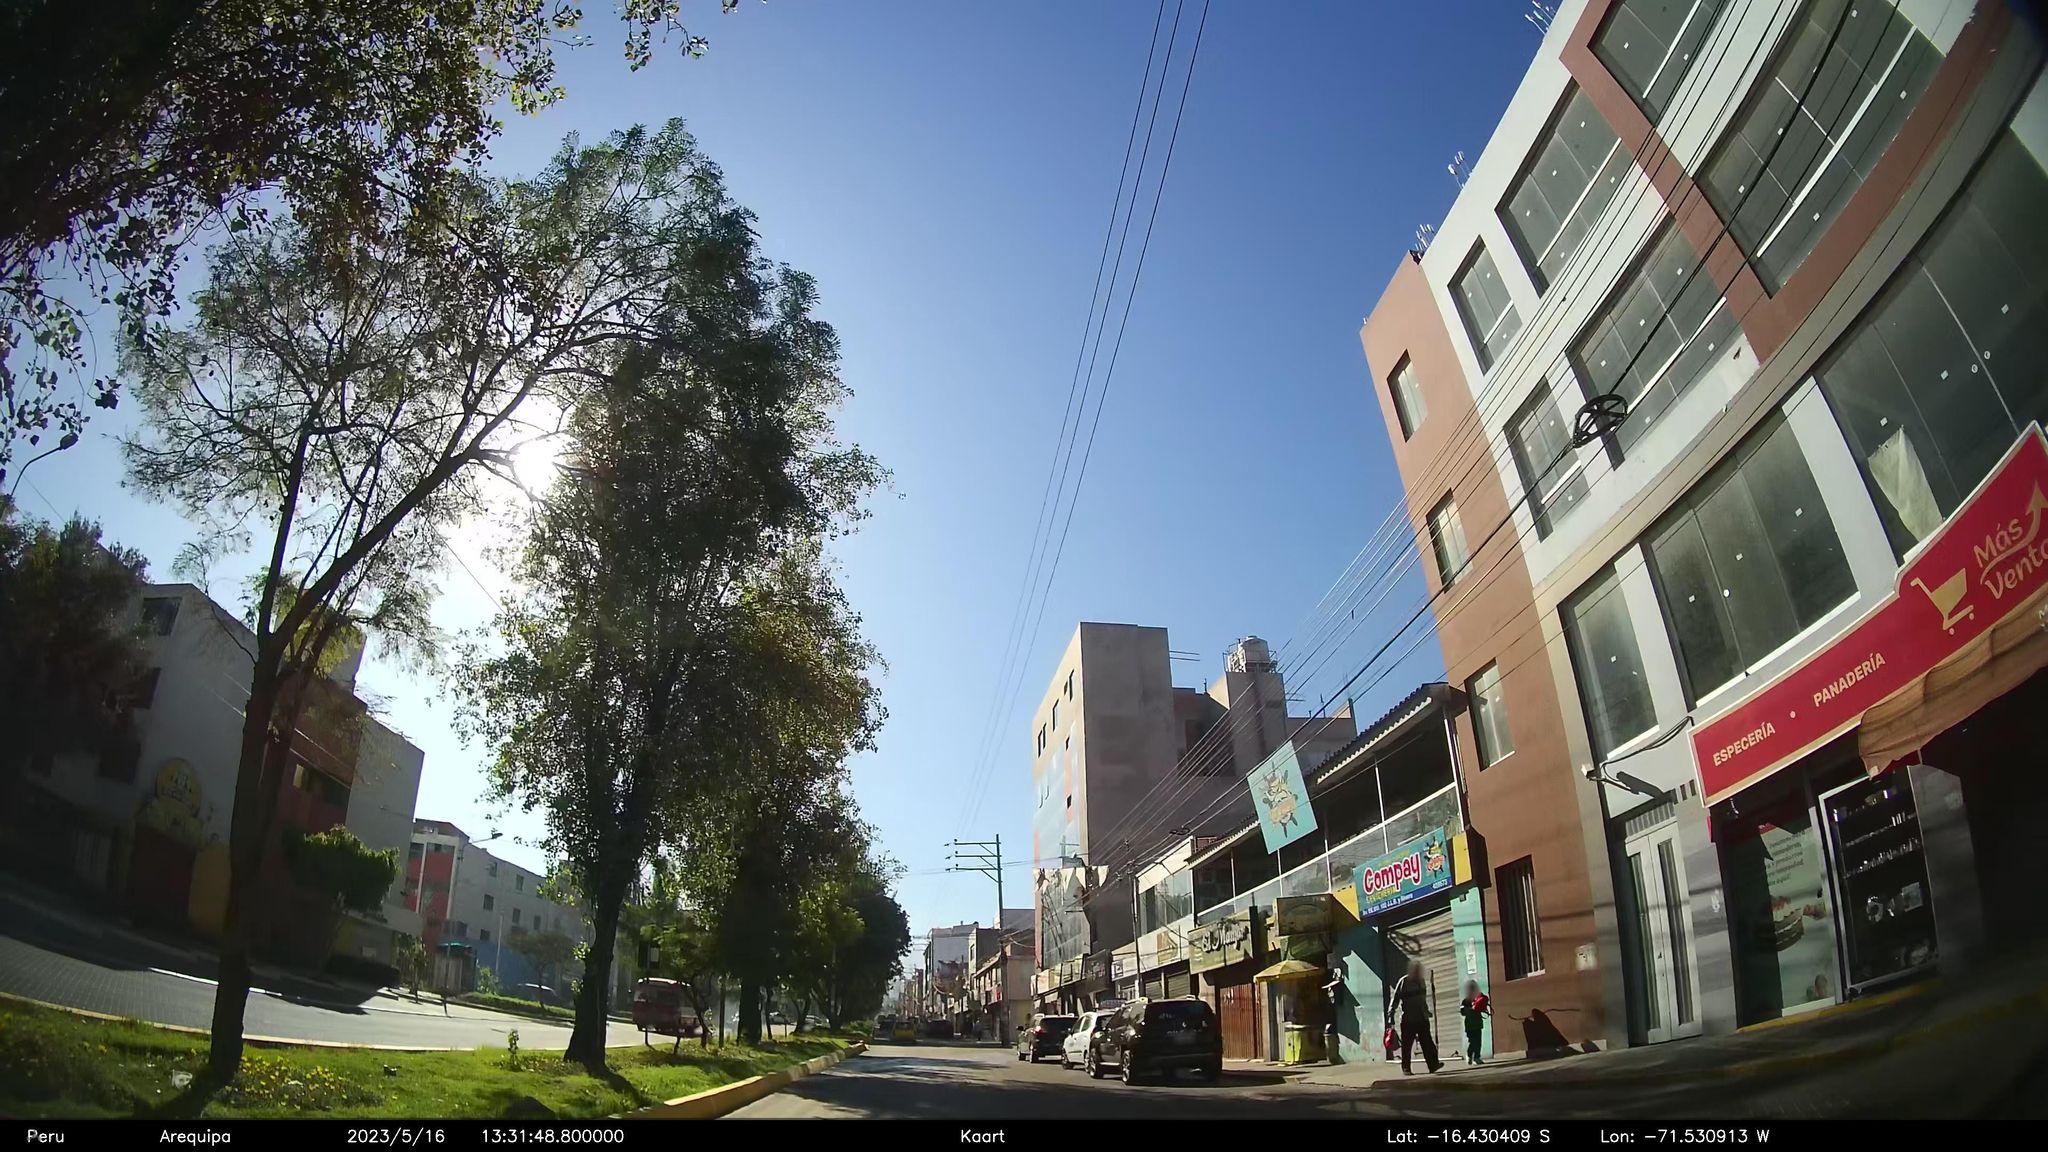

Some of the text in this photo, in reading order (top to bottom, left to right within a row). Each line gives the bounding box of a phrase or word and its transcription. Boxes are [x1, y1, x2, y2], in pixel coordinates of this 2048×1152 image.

[1973, 517, 2023, 569] Más
[1712, 652, 1886, 767] ESPECERÍA PANADERÍA
[1363, 852, 1422, 895] Compay
